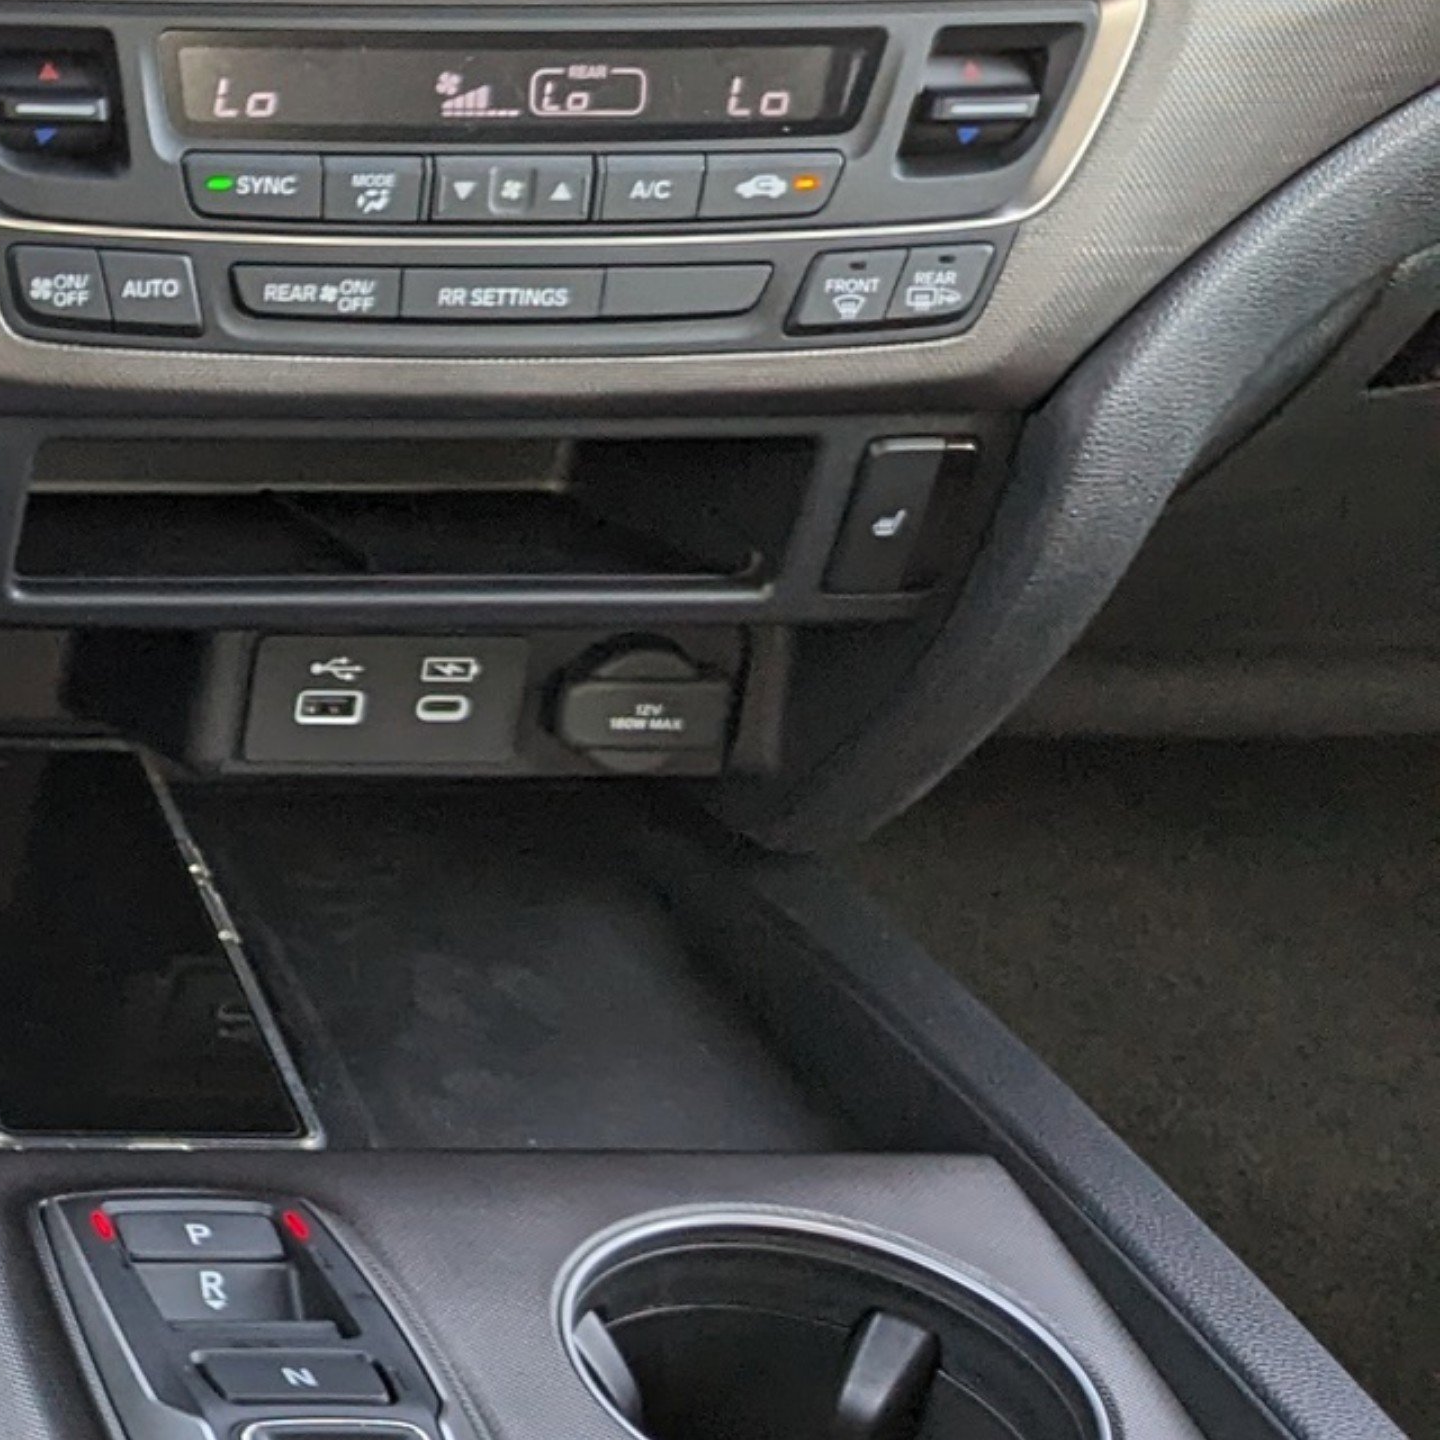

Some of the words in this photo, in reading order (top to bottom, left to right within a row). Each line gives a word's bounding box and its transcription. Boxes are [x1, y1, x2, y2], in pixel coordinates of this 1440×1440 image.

[568, 63, 606, 79] REAR
[211, 76, 278, 119] Lo
[727, 76, 790, 118] Lo
[236, 175, 299, 196] SYNC
[351, 173, 396, 189] MODE
[629, 179, 673, 200] A/C
[52, 273, 90, 290] ON/
[121, 277, 179, 300] AUTO
[338, 278, 376, 295] ON/
[824, 277, 880, 295] FRONT
[913, 270, 957, 286] REAR
[52, 290, 91, 309] OFF
[263, 283, 316, 304] REAR
[437, 287, 467, 307] RR
[471, 287, 569, 308] SETTINGS
[336, 295, 375, 314] OFF
[185, 1222, 211, 1245] P
[199, 1271, 226, 1301] R
[281, 1367, 318, 1389] N
